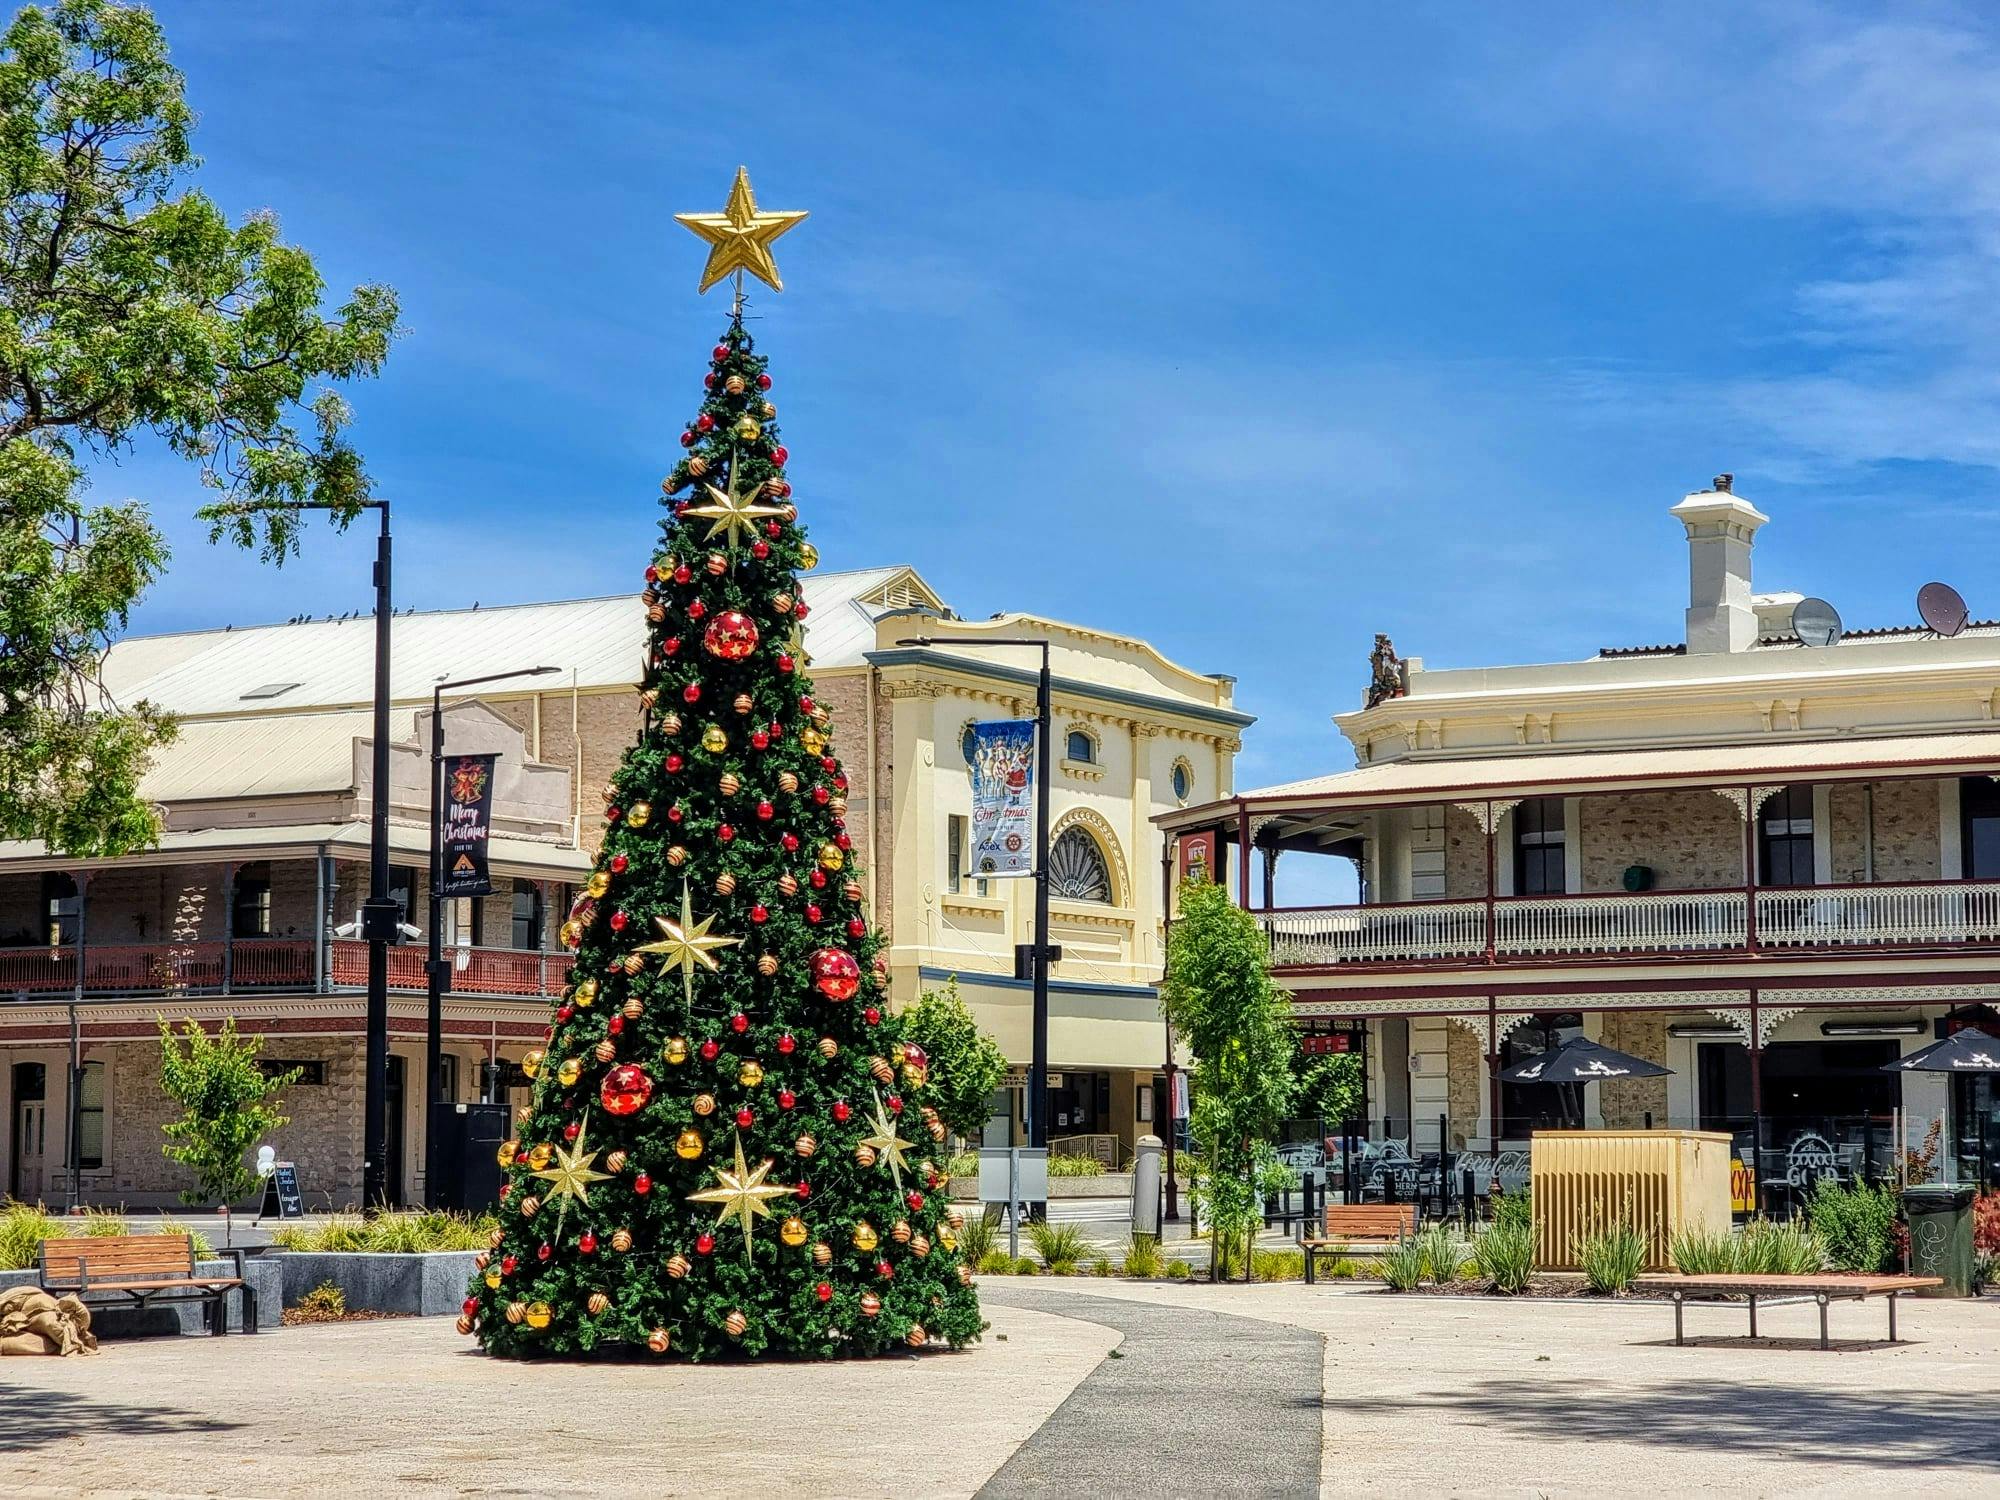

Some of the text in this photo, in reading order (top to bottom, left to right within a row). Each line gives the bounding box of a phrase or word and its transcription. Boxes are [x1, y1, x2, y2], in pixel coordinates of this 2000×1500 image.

[449, 804, 479, 824] Merry
[975, 807, 1029, 823] Chrtmas
[444, 822, 488, 843] Christmas
[1373, 1168, 1418, 1182] GEAT
